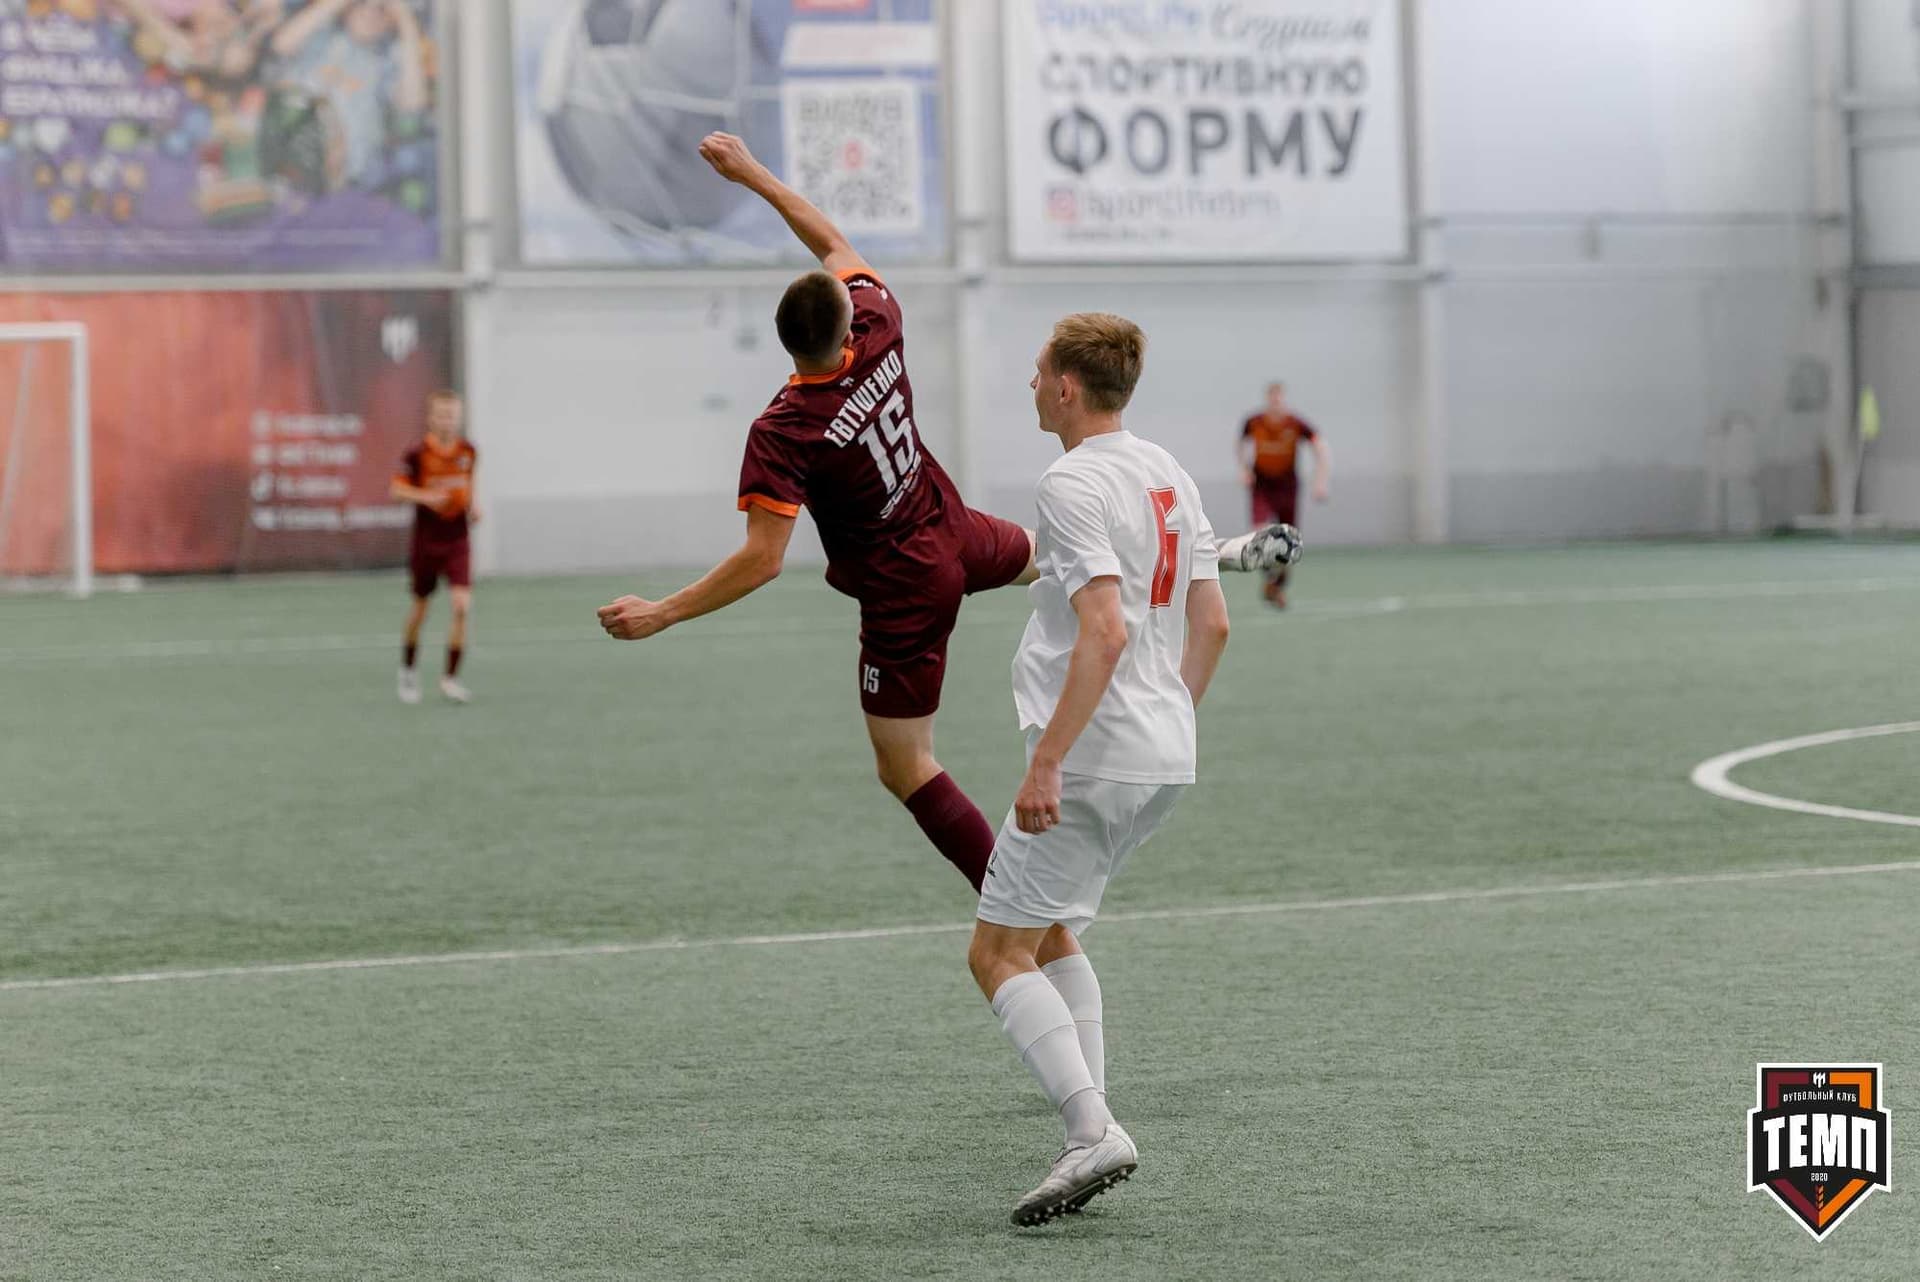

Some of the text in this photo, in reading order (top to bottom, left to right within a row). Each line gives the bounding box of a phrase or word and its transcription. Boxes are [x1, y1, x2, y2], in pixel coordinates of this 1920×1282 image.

[1041, 52, 1366, 94] СПОРТИВНУЮ
[1048, 106, 1363, 177] ФОРМУ
[824, 350, 903, 448] ЕВТУШЕНКО
[857, 389, 915, 496] 15
[863, 664, 880, 694] 15
